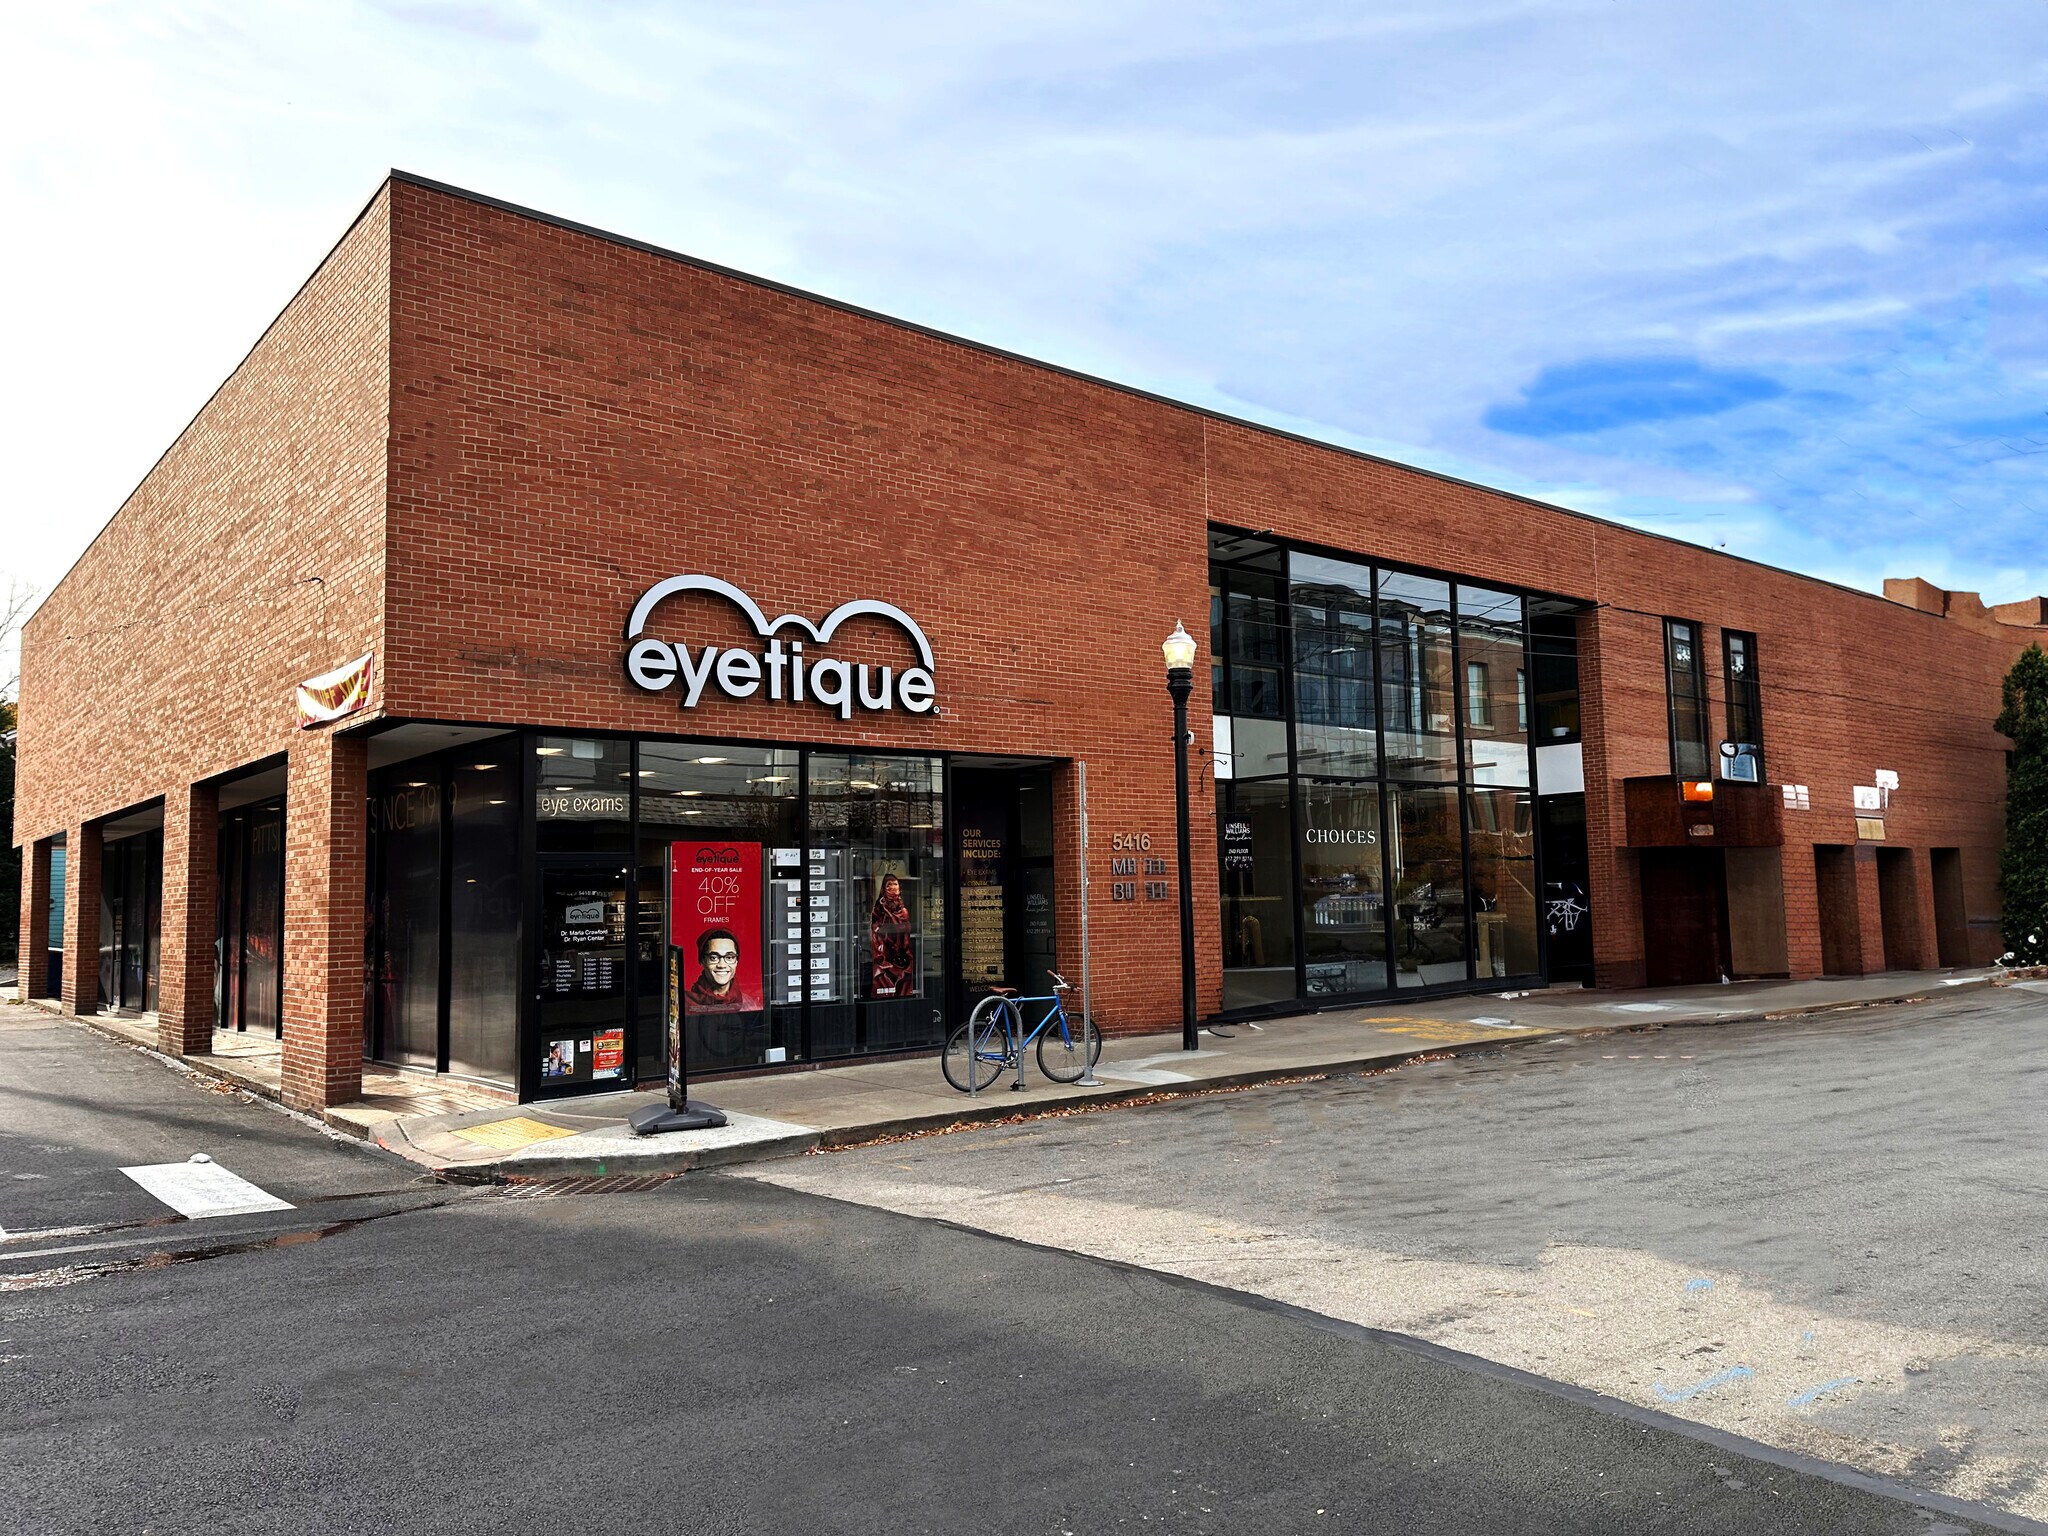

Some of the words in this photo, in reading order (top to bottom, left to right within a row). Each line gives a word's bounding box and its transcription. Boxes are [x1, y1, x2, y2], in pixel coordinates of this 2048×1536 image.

[628, 638, 936, 719] eyetique
[541, 797, 569, 817] eye
[573, 797, 624, 812] exams
[962, 829, 981, 837] OUR
[1306, 828, 1376, 844] CHOICES
[962, 839, 1001, 848] SERVICES
[1112, 832, 1151, 851] 5416
[696, 855, 740, 865] eyetique
[963, 850, 1001, 858] INCLUDE:
[698, 876, 739, 894] 40%
